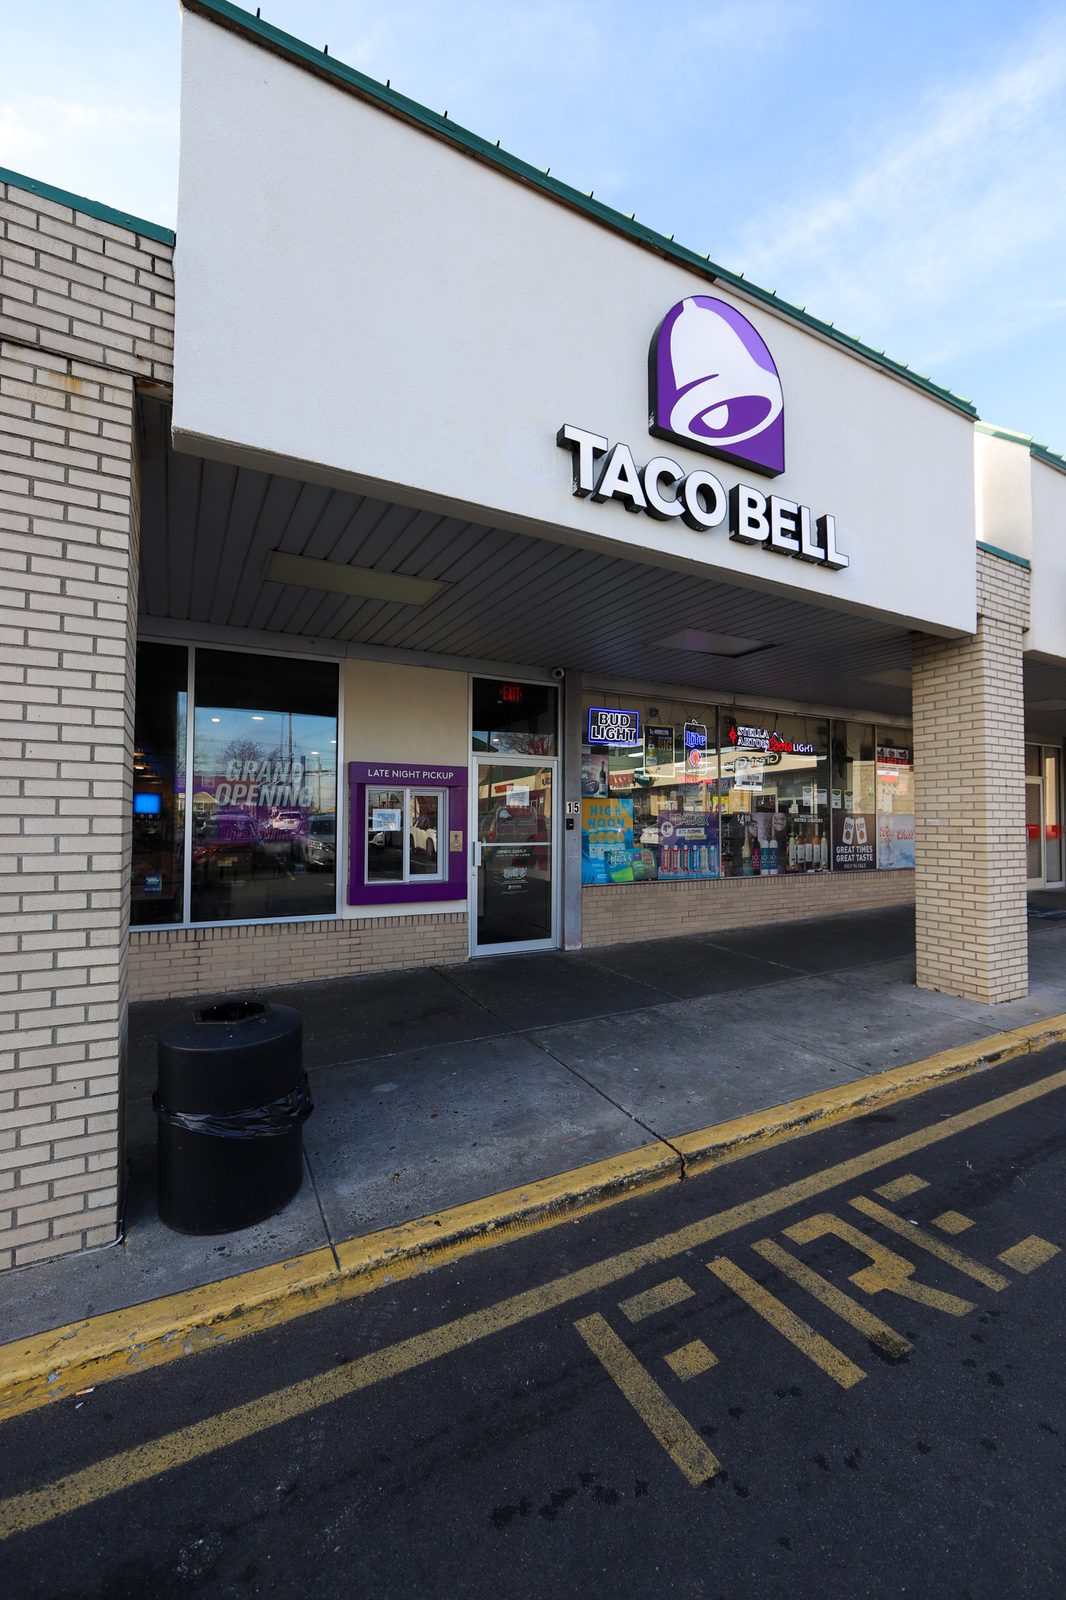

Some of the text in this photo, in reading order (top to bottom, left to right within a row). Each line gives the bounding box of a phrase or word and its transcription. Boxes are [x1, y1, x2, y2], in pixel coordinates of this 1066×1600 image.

[557, 424, 849, 571] TACO BELL
[503, 686, 521, 700] EXIT
[598, 712, 630, 726] BUD
[591, 726, 636, 742] LIGHT
[685, 731, 706, 748] Lite
[737, 727, 769, 739] STELLA
[737, 737, 769, 749] ARTOIS
[768, 737, 813, 753] Coors LIGHT
[226, 759, 305, 784] GRAND
[368, 769, 454, 780] LATE NIGHT PICKUP
[215, 783, 314, 807] OPENING
[566, 802, 579, 813] 15
[590, 805, 623, 816] HIGH
[588, 818, 625, 828] NOON
[836, 845, 873, 854] GREAT TIMES
[836, 854, 855, 862] GREAT
[573, 1173, 1062, 1488] FIRE
